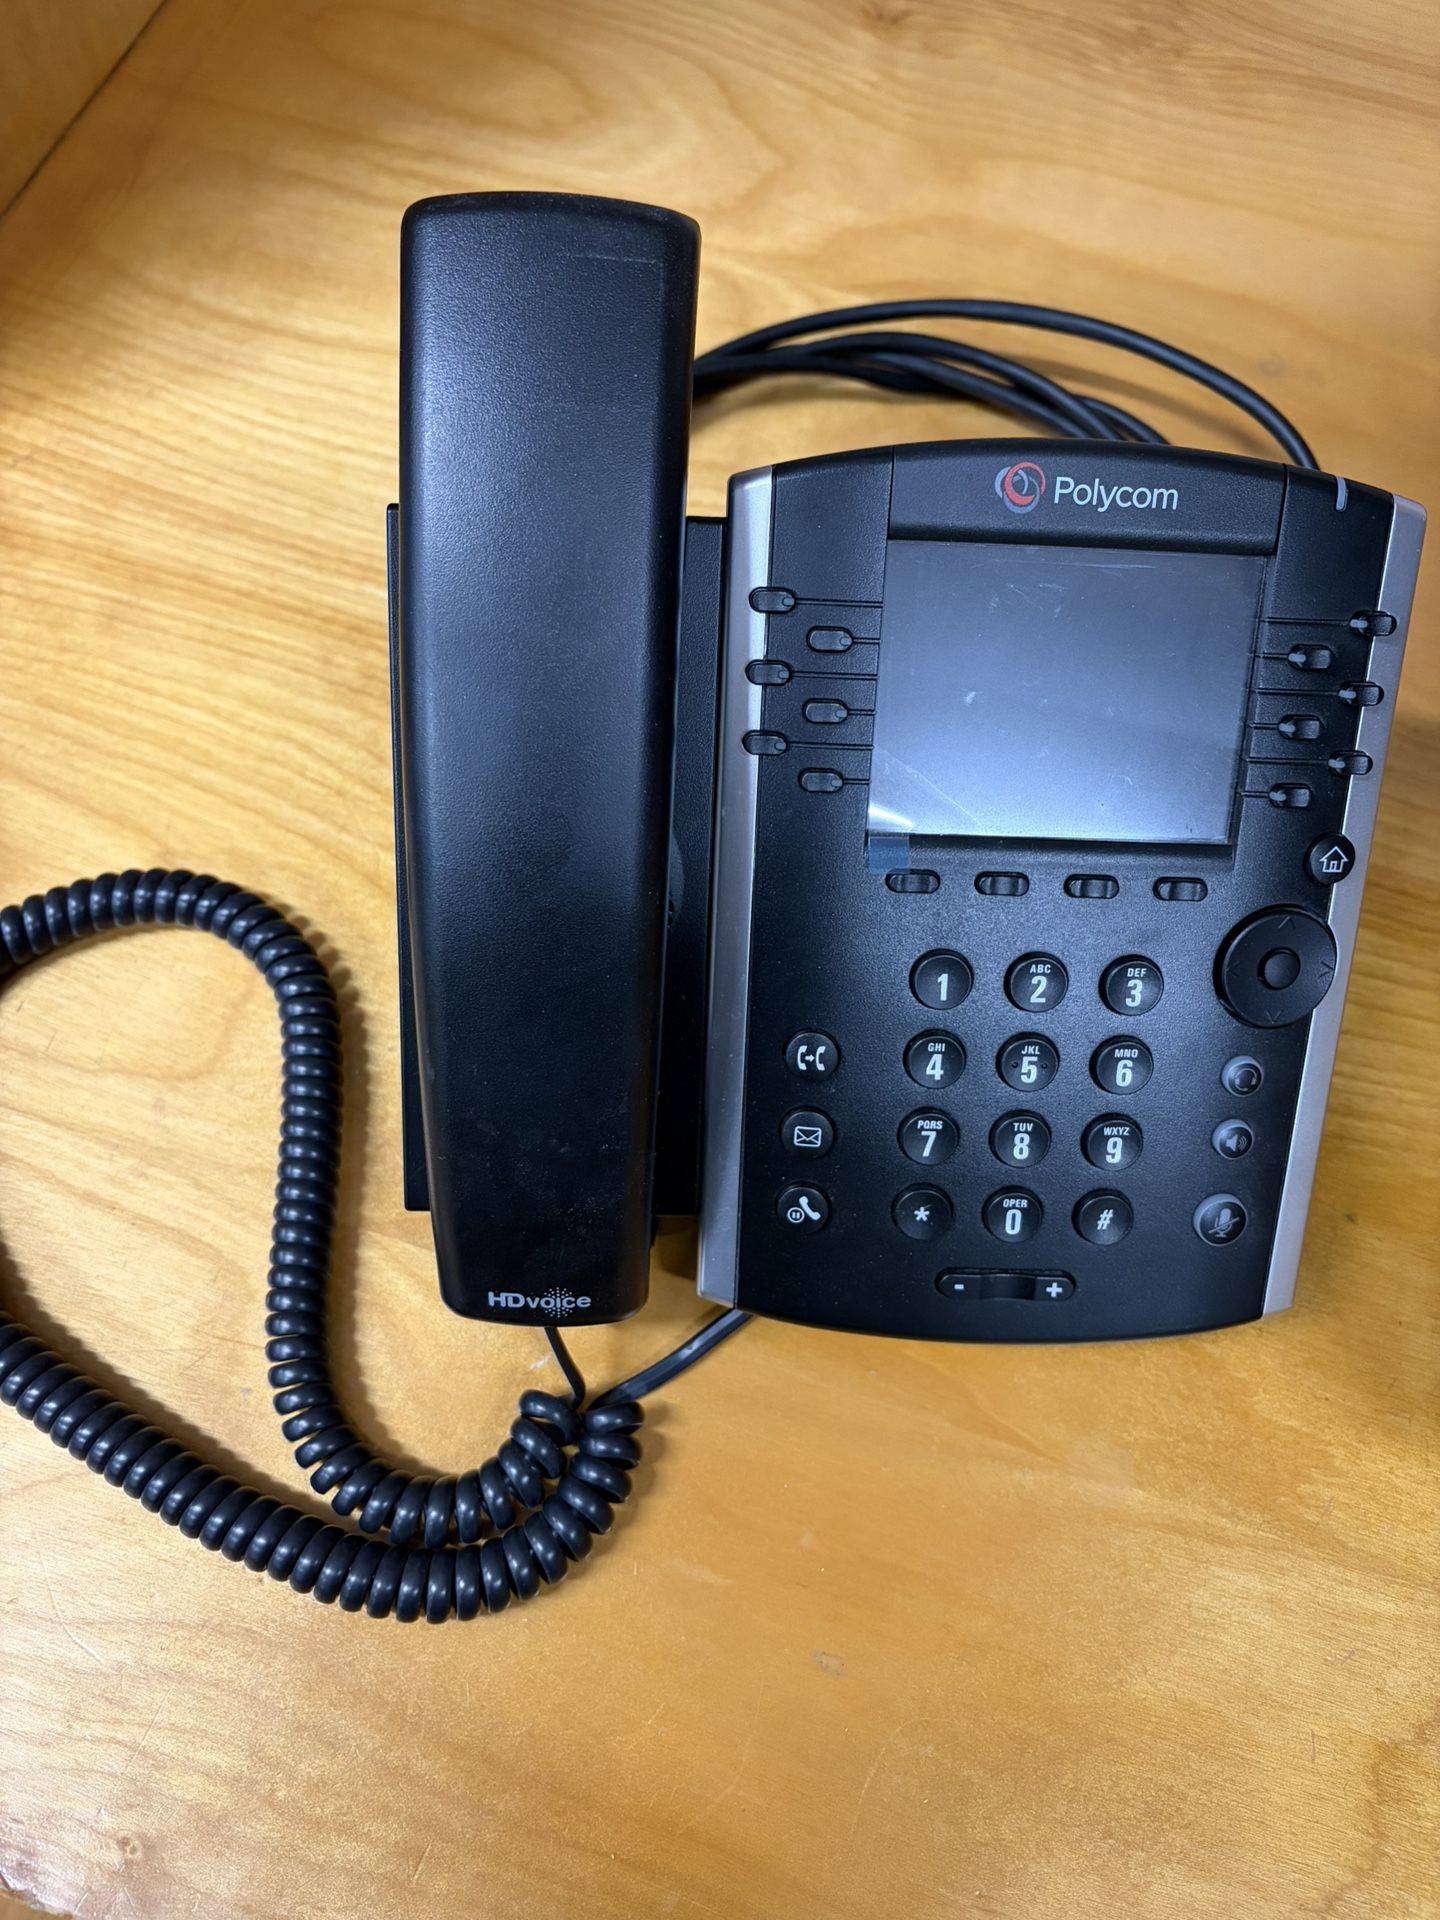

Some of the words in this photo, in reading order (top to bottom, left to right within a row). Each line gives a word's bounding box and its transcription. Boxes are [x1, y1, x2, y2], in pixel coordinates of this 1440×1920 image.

[1054, 476, 1178, 512] Polycom
[1030, 964, 1051, 974] ABC
[1127, 968, 1147, 978] DEF
[937, 973, 949, 1001] 1
[1030, 975, 1047, 1003] 2
[1126, 979, 1143, 1007] 3
[928, 1043, 946, 1052] GHI
[1021, 1046, 1041, 1055] JKL
[1114, 1049, 1138, 1058] MNO
[926, 1054, 944, 1080] 4
[1020, 1056, 1038, 1083] 5
[1116, 1060, 1133, 1087] 6
[917, 1120, 943, 1130] PQRS
[1013, 1123, 1033, 1132] TUV
[1103, 1127, 1130, 1136] WXYZ
[921, 1131, 937, 1157] 7
[1013, 1133, 1030, 1159] 8
[1106, 1137, 1123, 1164] 9
[1003, 1199, 1028, 1208] OPER
[1005, 1209, 1022, 1235] 0
[1097, 1209, 1114, 1230] #
[487, 1291, 592, 1309] HDvoice
